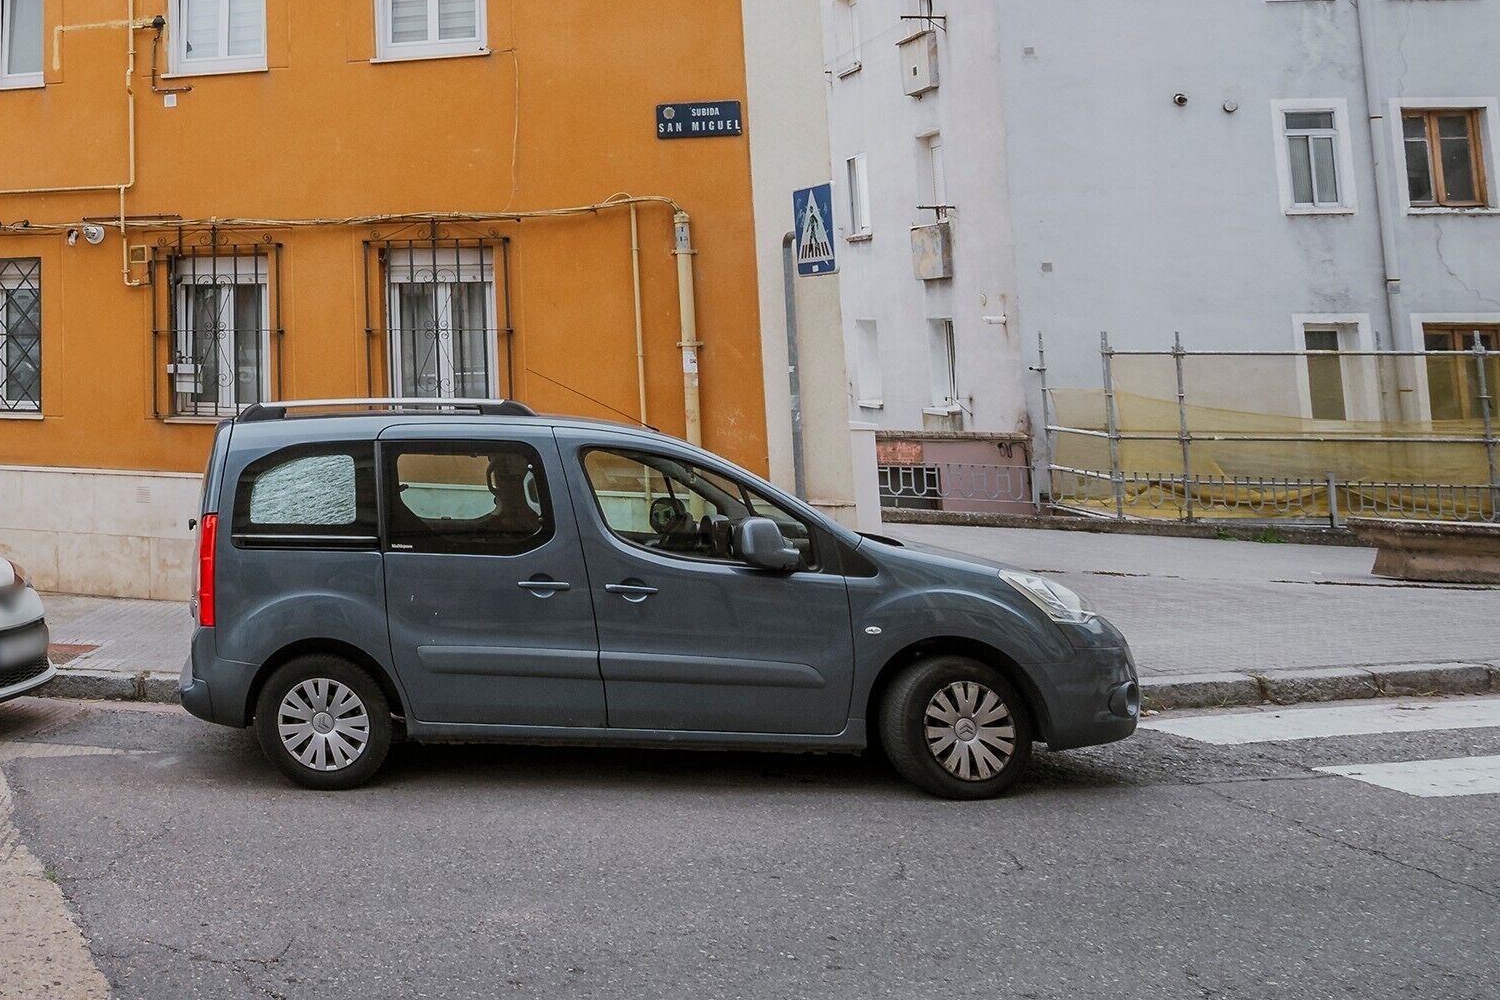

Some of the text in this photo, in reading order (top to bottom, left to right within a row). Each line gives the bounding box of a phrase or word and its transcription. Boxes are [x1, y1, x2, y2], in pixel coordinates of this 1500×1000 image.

[691, 107, 719, 116] SUBIDA
[658, 120, 740, 133] SAN MIGUEL
